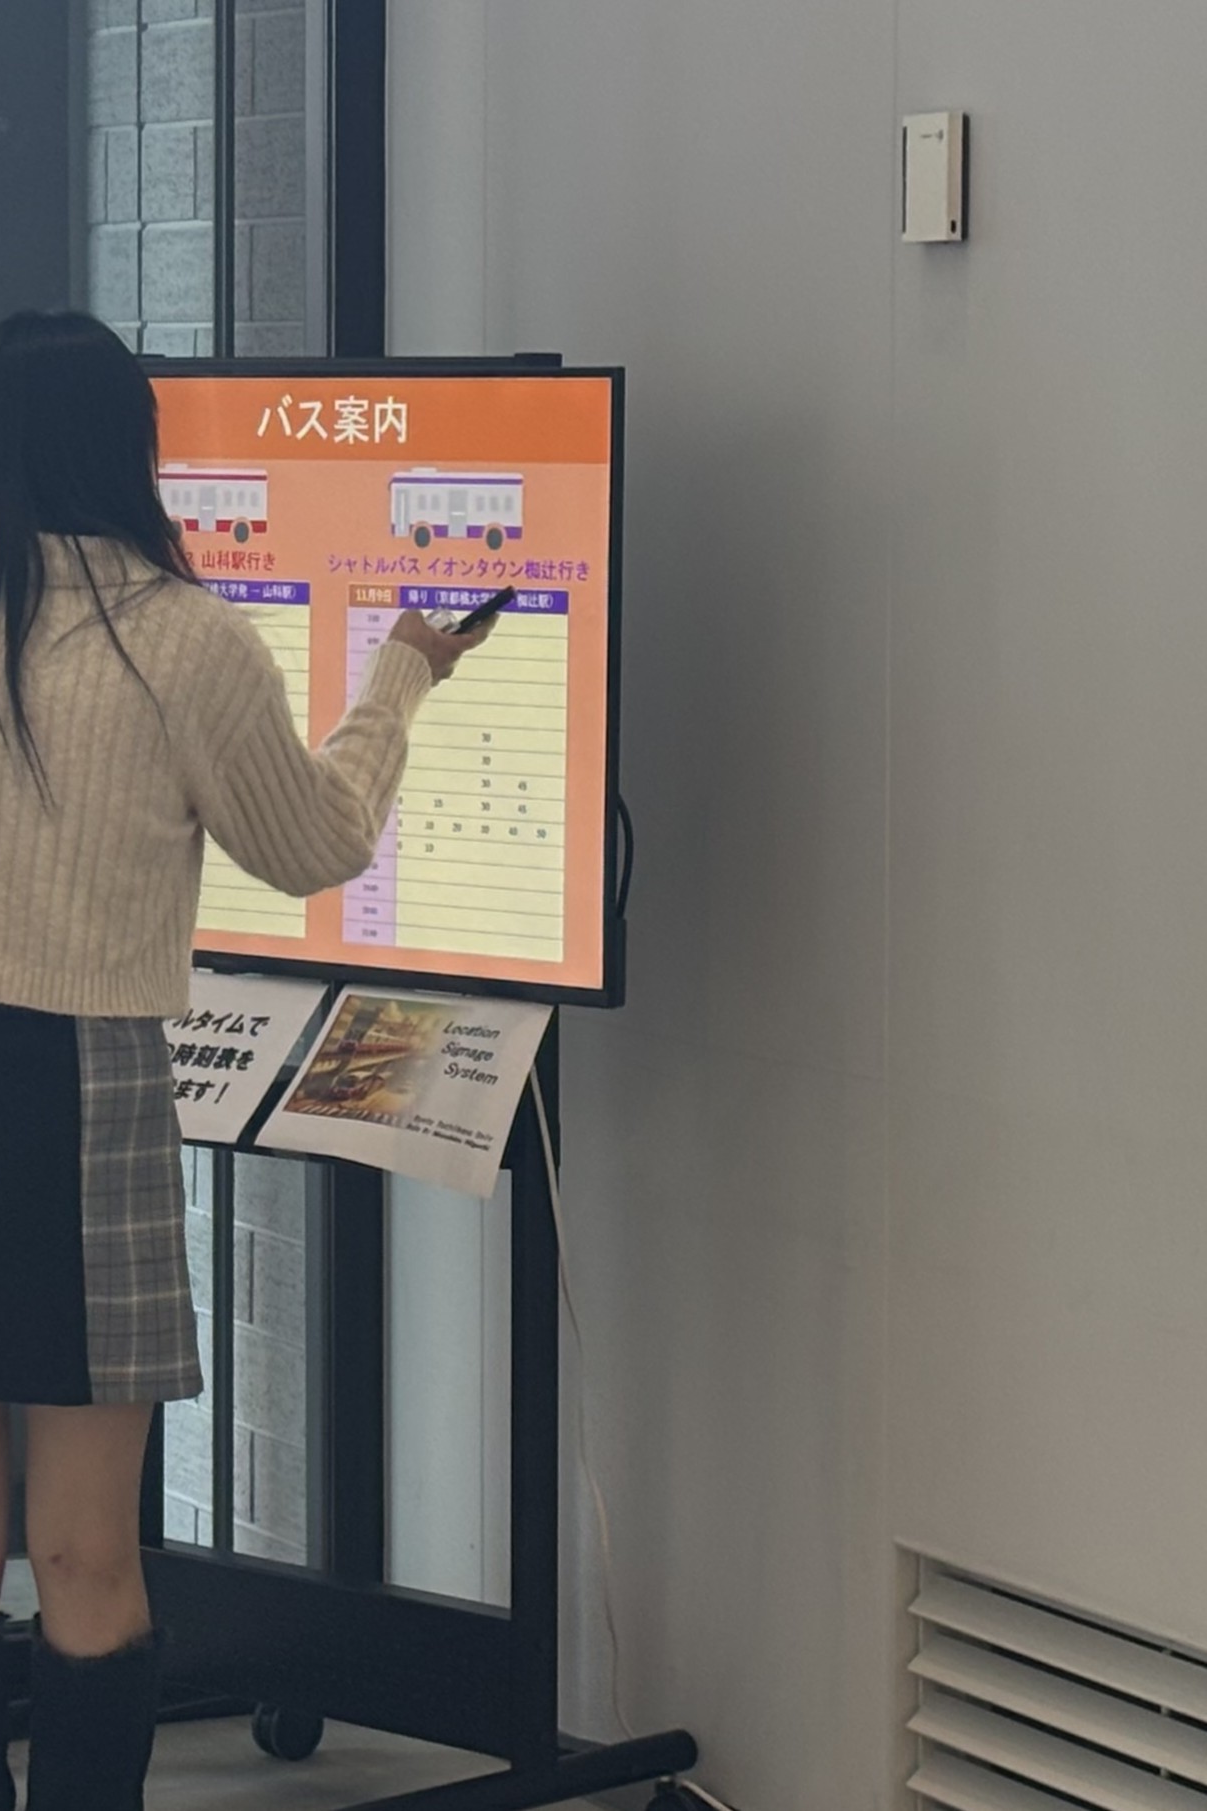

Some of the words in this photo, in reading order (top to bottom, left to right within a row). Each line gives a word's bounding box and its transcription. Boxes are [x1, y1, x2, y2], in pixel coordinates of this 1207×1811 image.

[257, 394, 407, 445] バス案内
[201, 551, 276, 571] 山科駅行き
[328, 555, 421, 576] シャトルバス
[442, 1021, 501, 1039] Location
[441, 1041, 494, 1062] Signage
[444, 1062, 499, 1085] System
[173, 1078, 230, 1105] ます！
